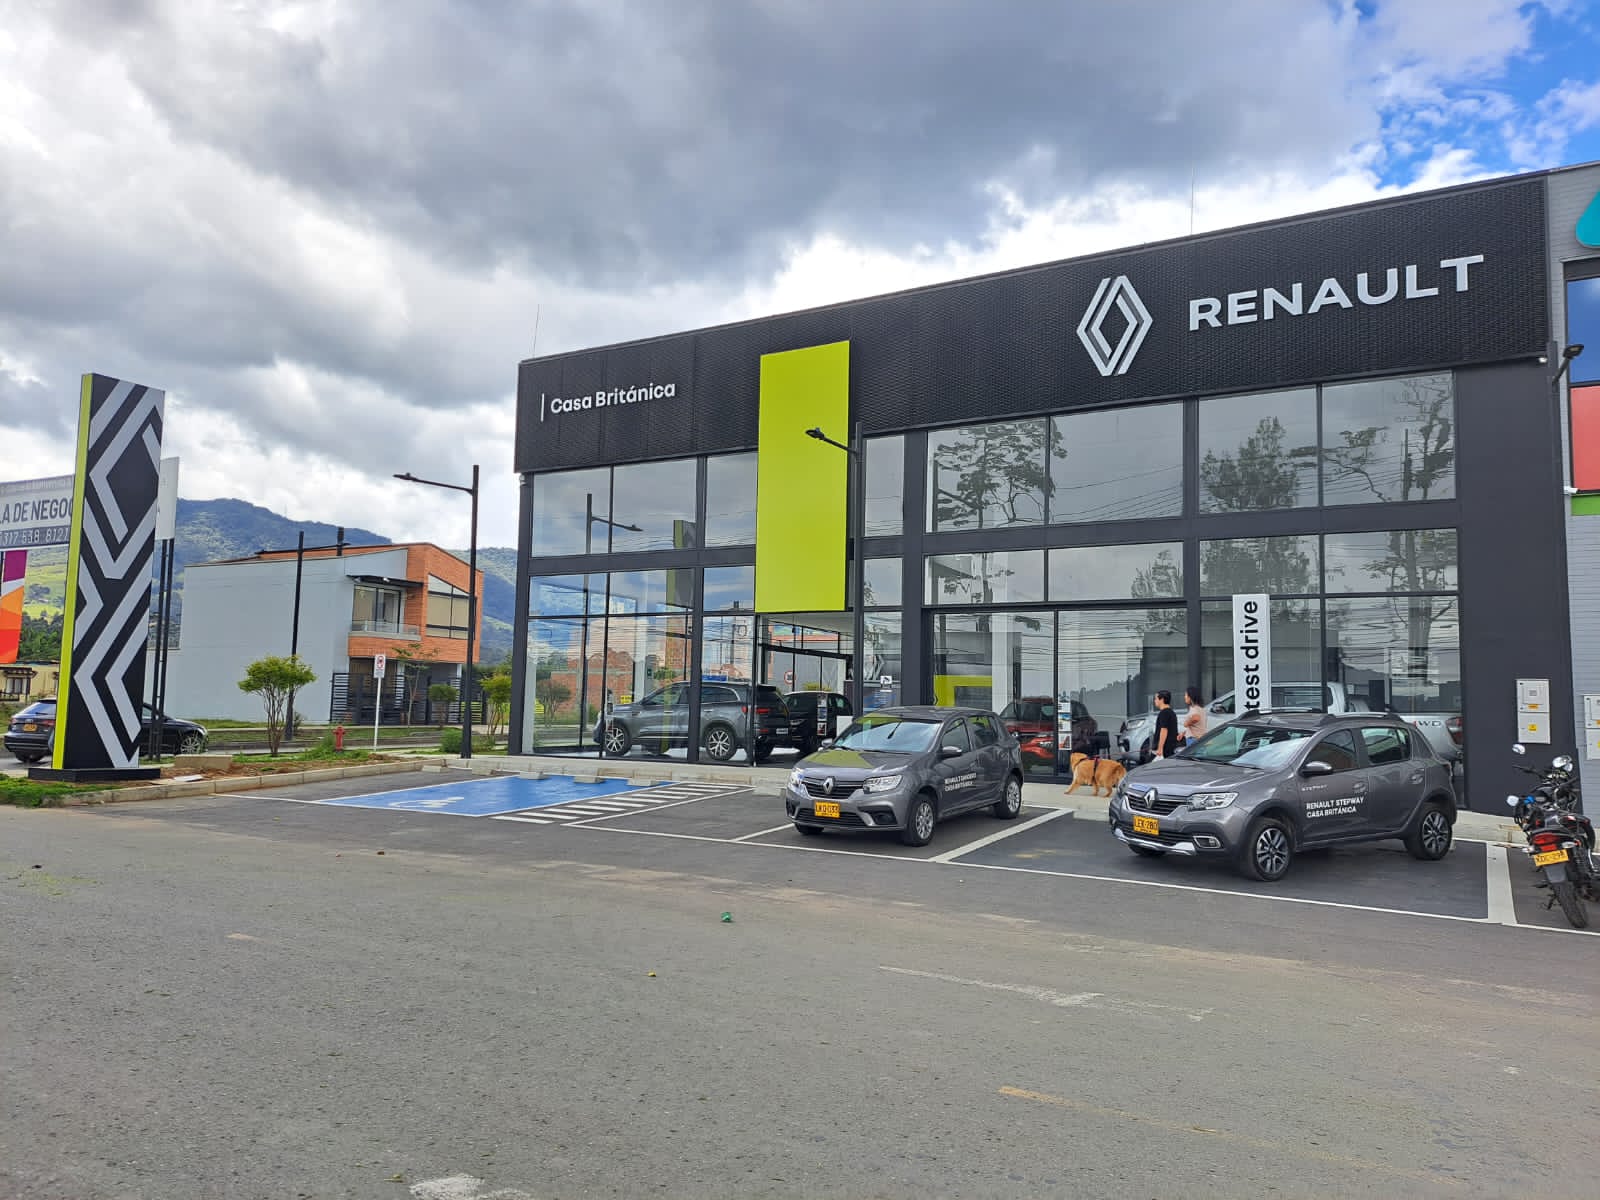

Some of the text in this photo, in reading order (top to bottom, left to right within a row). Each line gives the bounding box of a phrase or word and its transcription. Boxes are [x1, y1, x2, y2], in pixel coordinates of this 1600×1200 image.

[1188, 254, 1484, 331] RENAULT
[550, 382, 676, 414] Casa Británica
[0, 503, 10, 524] A
[12, 501, 30, 523] DE
[1239, 600, 1261, 711] test drive
[1306, 796, 1364, 810] RENAULT STEPWAY
[1306, 809, 1324, 818] CASA
